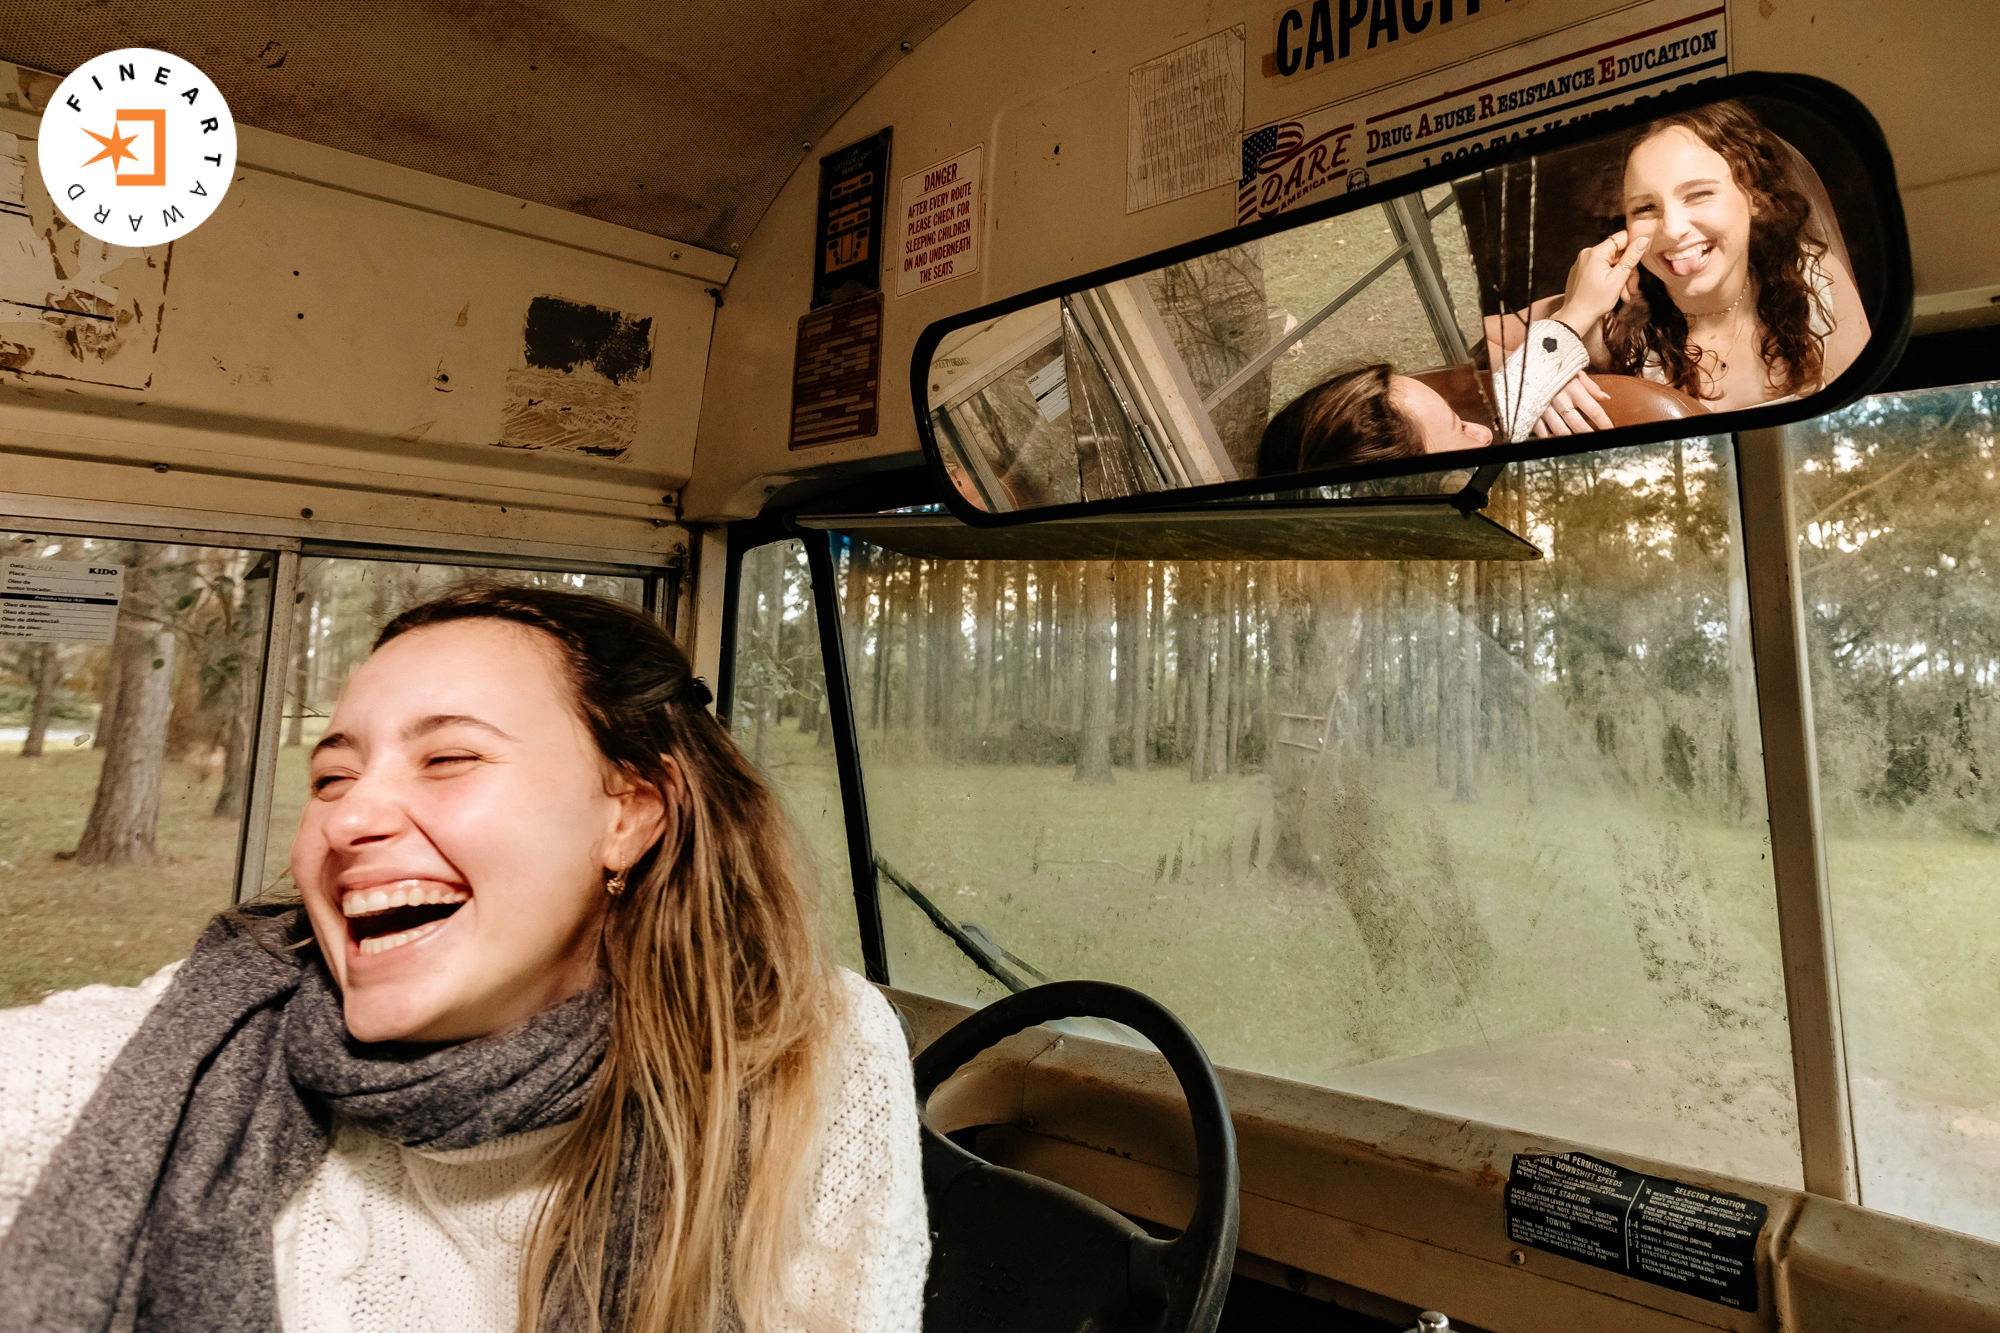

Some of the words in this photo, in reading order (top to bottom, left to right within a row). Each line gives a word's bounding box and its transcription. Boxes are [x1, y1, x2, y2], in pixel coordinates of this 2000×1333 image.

[1366, 124, 1412, 154] DRUG
[1415, 104, 1475, 139] ABUSE
[1478, 68, 1595, 121] RESISTANCE
[1598, 29, 1718, 85] EDUCATION
[924, 162, 958, 192] DANGER
[908, 199, 928, 219] AFTER
[929, 190, 949, 211] EVERY
[950, 181, 972, 203] ROUTE
[1280, 178, 1327, 211] AMERICA
[908, 215, 931, 236] PLEASE
[933, 206, 955, 227] CHECK
[956, 200, 970, 218] FOR
[905, 231, 936, 255] SLEEPING
[937, 218, 971, 243] CHILDREN
[904, 257, 913, 272] ON
[914, 252, 928, 269] AND
[929, 236, 971, 264] UNDERNEATH
[919, 268, 932, 284] THE
[933, 260, 954, 280] SEATS
[1517, 1164, 1536, 1174] HIGHER
[1537, 1169, 1550, 1178] THAN
[1561, 1176, 1584, 1187] MAXIMUM
[1585, 1183, 1601, 1192] SPEED
[1555, 1161, 1595, 1179] DOWNSHIFT
[1596, 1173, 1623, 1188] SPEEDS
[1572, 1155, 1617, 1178] PERMISSIBLE
[1532, 1182, 1556, 1195] ENGINE
[1558, 1189, 1591, 1205] STARTING
[1599, 1183, 1615, 1192] SPEED
[1652, 1190, 1674, 1200] REVERSE
[1674, 1186, 1709, 1201] SELECTOR
[1711, 1195, 1746, 1210] POSITION
[1511, 1187, 1525, 1196] PLACE
[1526, 1191, 1549, 1202] SELECTOR
[1550, 1198, 1564, 1207] LEVER
[1571, 1204, 1594, 1215] NEUTRAL
[1595, 1210, 1618, 1222] POSITION
[1521, 1196, 1535, 1204] START
[1571, 1210, 1590, 1220] ENGINE
[1591, 1215, 1611, 1226] CANNOT
[1546, 1208, 1568, 1219] PUSHING
[1576, 1217, 1596, 1227] TOWING
[1680, 1202, 1702, 1212] REVERSE
[1703, 1208, 1717, 1216] WITH
[1718, 1212, 1740, 1222] VEHICLE
[1511, 1216, 1520, 1224] ANY
[1545, 1226, 1563, 1236] VEHICLE
[1545, 1215, 1571, 1230] TOWING
[1627, 1218, 1638, 1229] 1-4
[1663, 1229, 1688, 1242] FORWARD
[1685, 1215, 1706, 1225] VEHICLE
[1529, 1232, 1548, 1243] DRIVING
[1549, 1238, 1568, 1249] WHEELS
[1569, 1244, 1585, 1254] LIFTED
[1586, 1249, 1596, 1257] OFF
[1543, 1231, 1555, 1239] REAR
[1556, 1235, 1571, 1244] AXLES
[1571, 1239, 1585, 1248] MUST
[1595, 1246, 1618, 1258] REMOVED
[1628, 1228, 1638, 1238] 1-3
[1640, 1233, 1661, 1244] HEAVILY
[1662, 1239, 1683, 1250] LOADED
[1684, 1245, 1710, 1257] HIGHWAY
[1628, 1238, 1639, 1248] 1-2
[1640, 1242, 1652, 1250] LOW
[1653, 1246, 1669, 1255] SPEED
[1670, 1250, 1701, 1264] OPERATION
[1702, 1259, 1714, 1268] AND
[1715, 1263, 1740, 1275] GREATER
[1641, 1248, 1667, 1260] EFFECTIVE
[1669, 1256, 1688, 1266] ENGINE
[1642, 1263, 1661, 1274] ENGINE
[1641, 1257, 1658, 1266] EXTRA
[1659, 1262, 1676, 1272] HEAVY
[1677, 1267, 1694, 1277] LOADS
[1699, 1273, 1727, 1286] MAXIMUM
